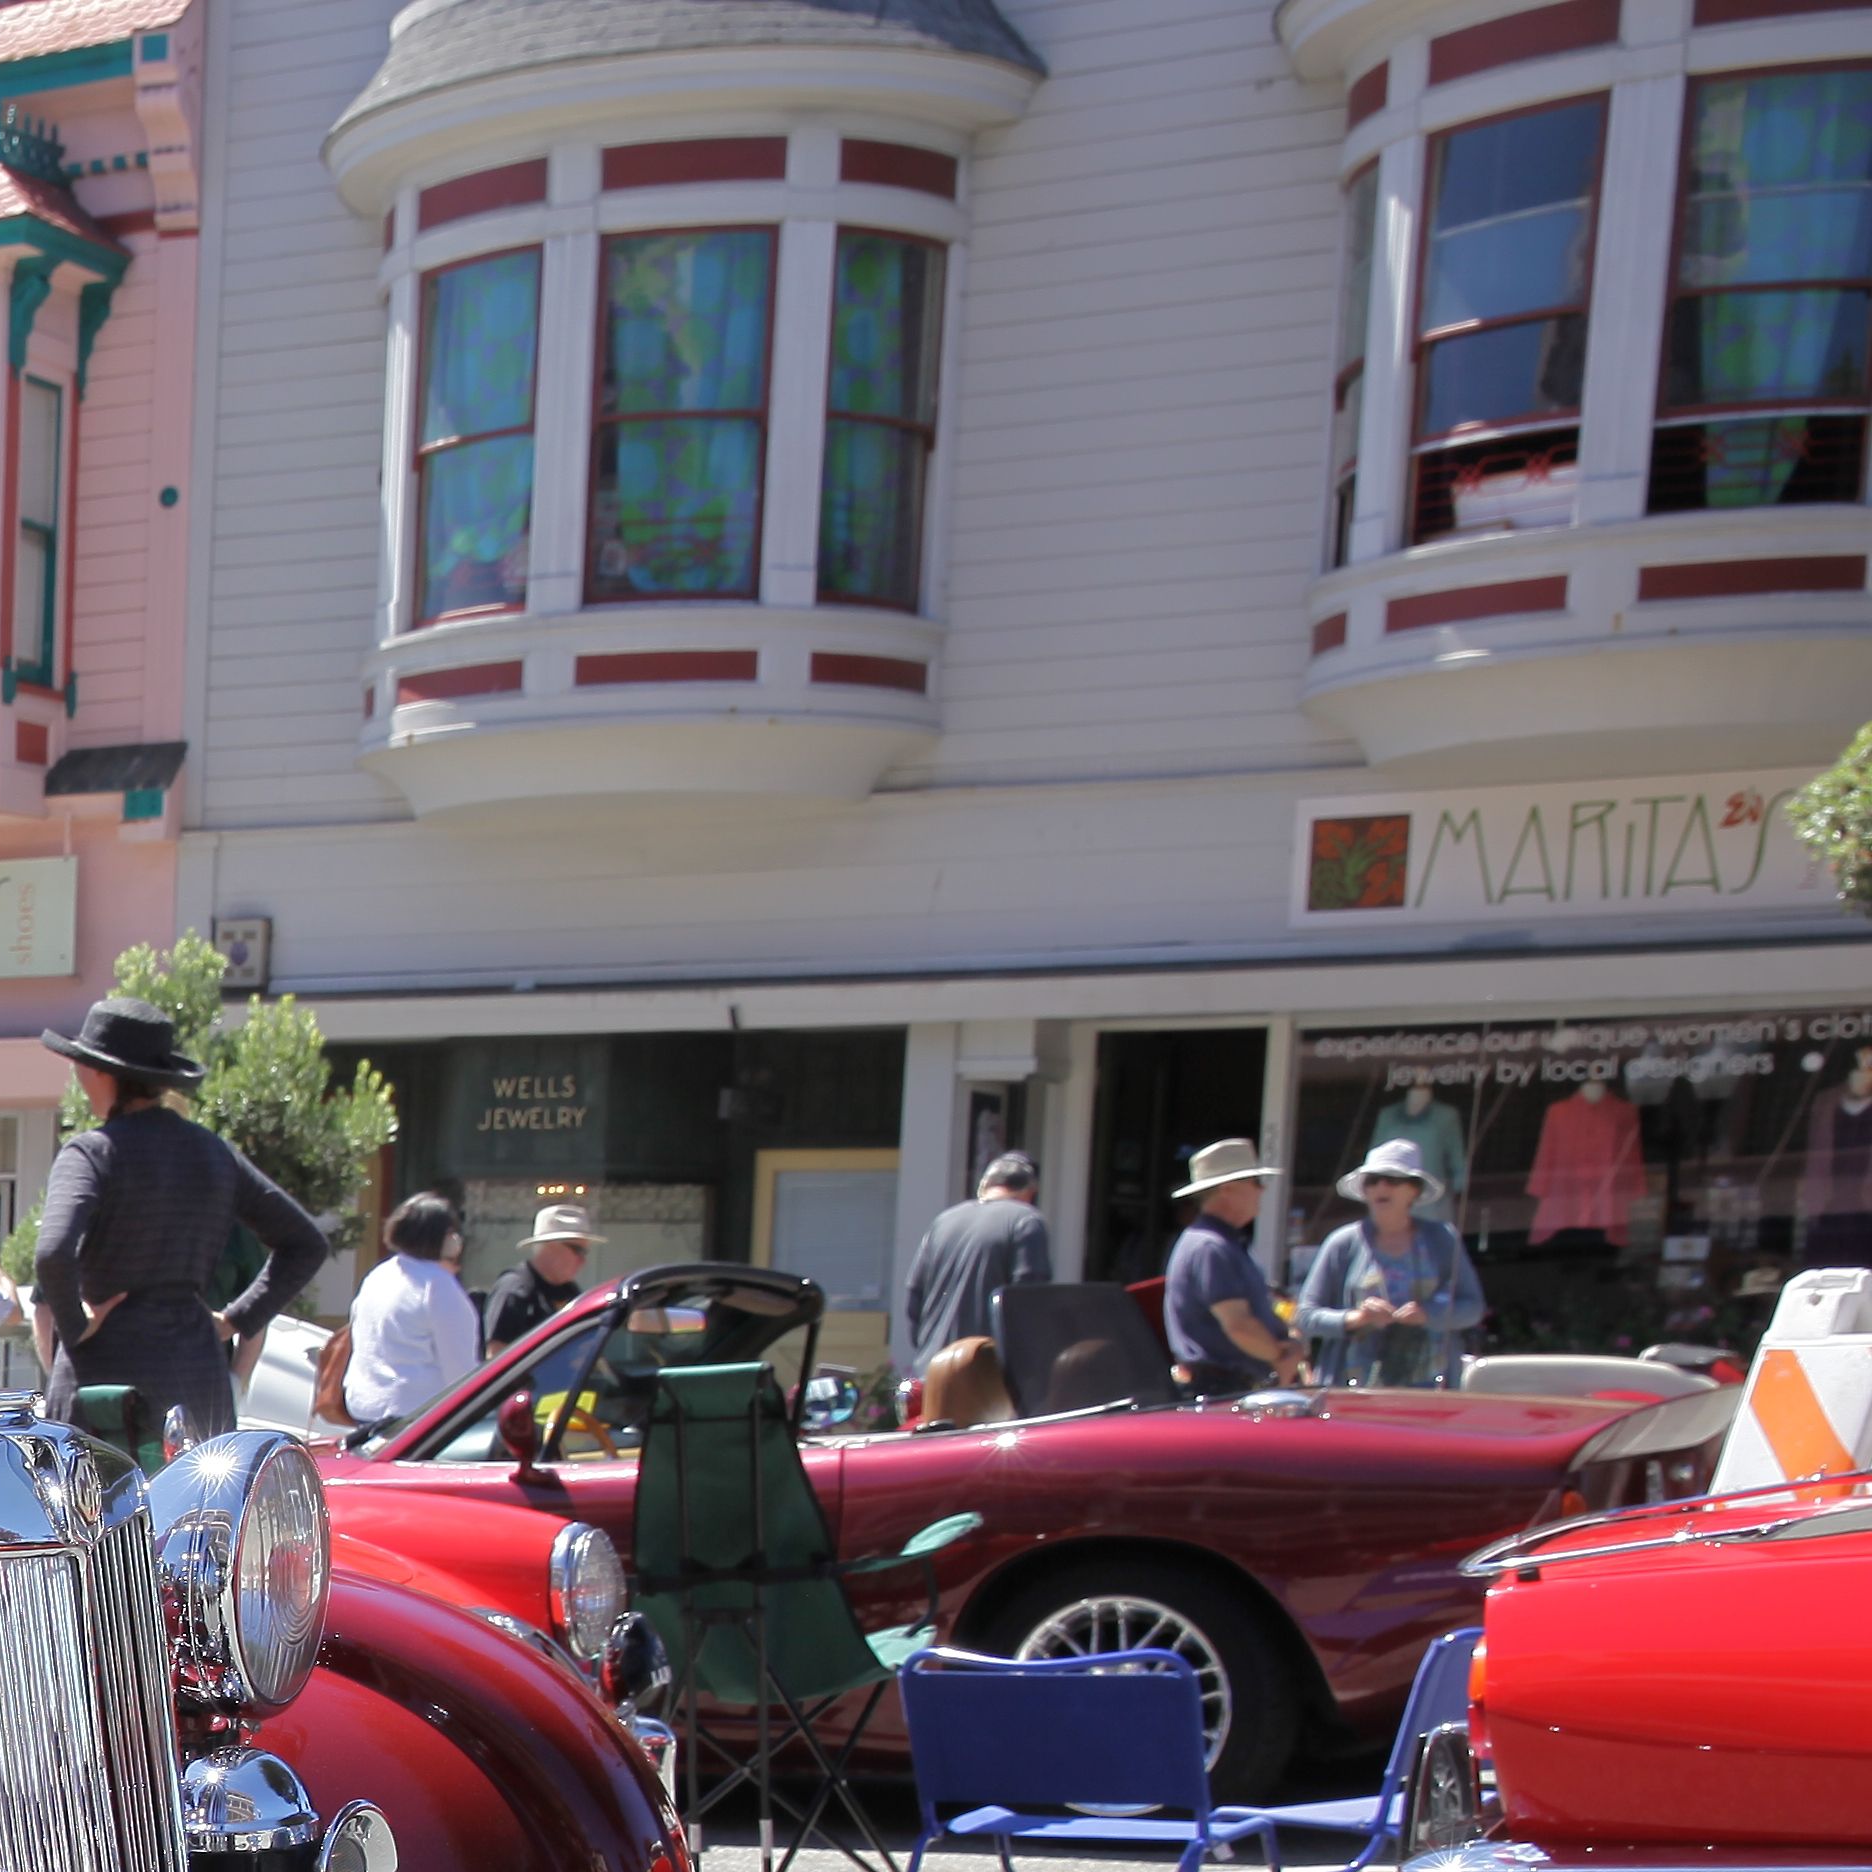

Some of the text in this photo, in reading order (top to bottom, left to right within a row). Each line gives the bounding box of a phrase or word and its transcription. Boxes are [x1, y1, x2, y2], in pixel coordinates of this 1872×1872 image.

[7, 883, 34, 965] shoes
[1314, 1030, 1481, 1061] experience
[1483, 1029, 1535, 1052] our
[1656, 1016, 1803, 1046] women's
[492, 1074, 577, 1099] WELLS
[1383, 1059, 1492, 1092] jewelry
[1495, 1058, 1537, 1088] by
[1541, 1054, 1619, 1081] local
[477, 1105, 588, 1131] JEWELRY
